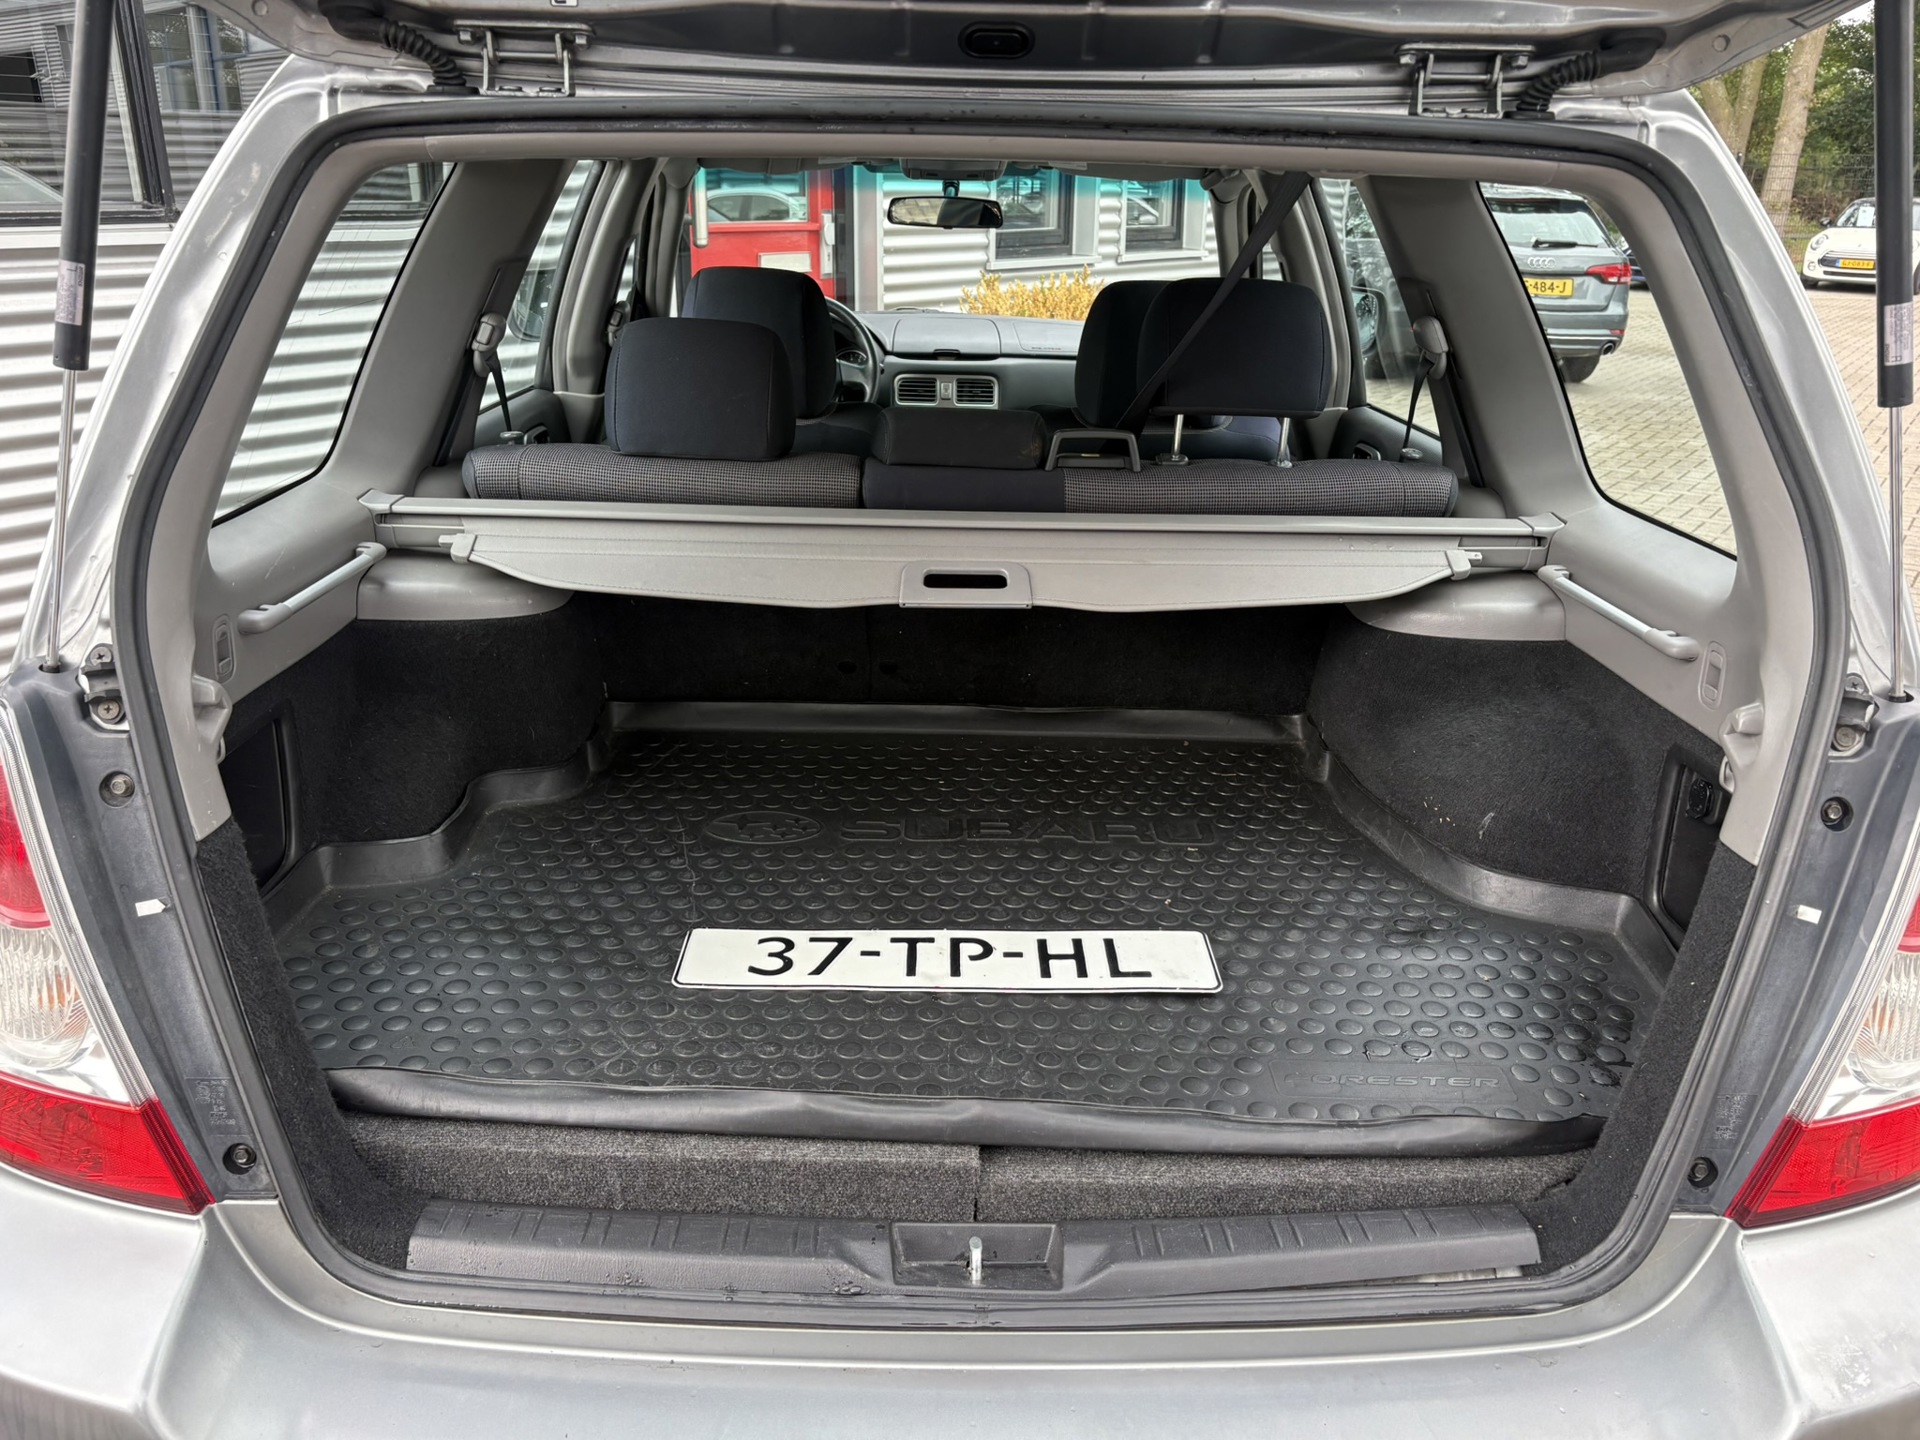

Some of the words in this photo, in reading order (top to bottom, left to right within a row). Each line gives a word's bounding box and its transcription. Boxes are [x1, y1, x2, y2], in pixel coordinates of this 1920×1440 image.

[841, 817, 1216, 846] SUBARU
[748, 936, 1153, 979] 37-TP-HL
[1284, 1073, 1500, 1088] FORESTER
